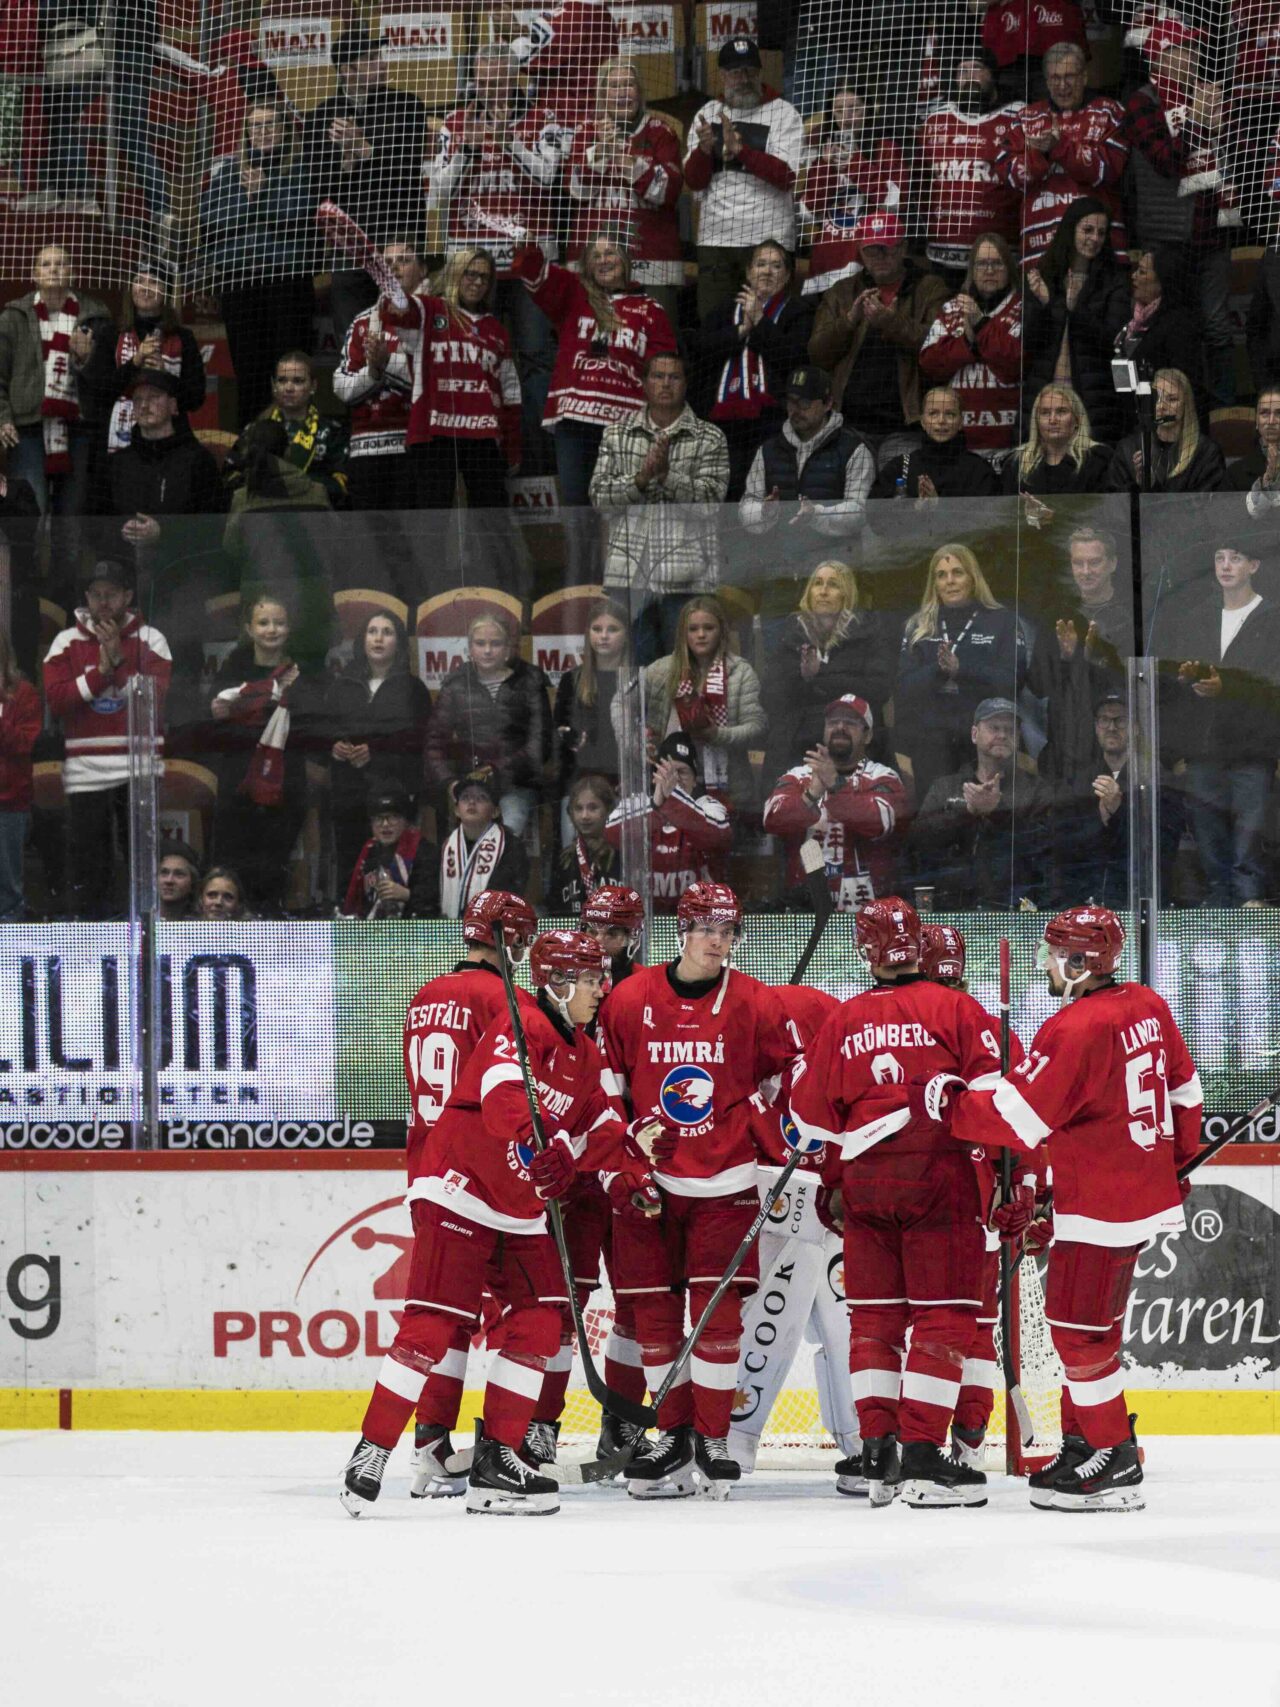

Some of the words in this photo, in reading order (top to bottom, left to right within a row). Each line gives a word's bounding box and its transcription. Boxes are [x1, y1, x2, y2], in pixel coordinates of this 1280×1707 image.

[476, 836, 496, 876] 1928
[0, 953, 258, 1072] ILIM
[648, 1033, 725, 1064] TIMRÅ
[1014, 1049, 1050, 1084] 51
[408, 1032, 459, 1127] 19
[1125, 1049, 1175, 1152] 51
[0, 1114, 124, 1149] dcode
[168, 1112, 375, 1149] Brandcode
[782, 1147, 808, 1166] RD
[749, 1194, 775, 1237] BAUER
[790, 1186, 807, 1234] COOR
[6, 1255, 61, 1340] g
